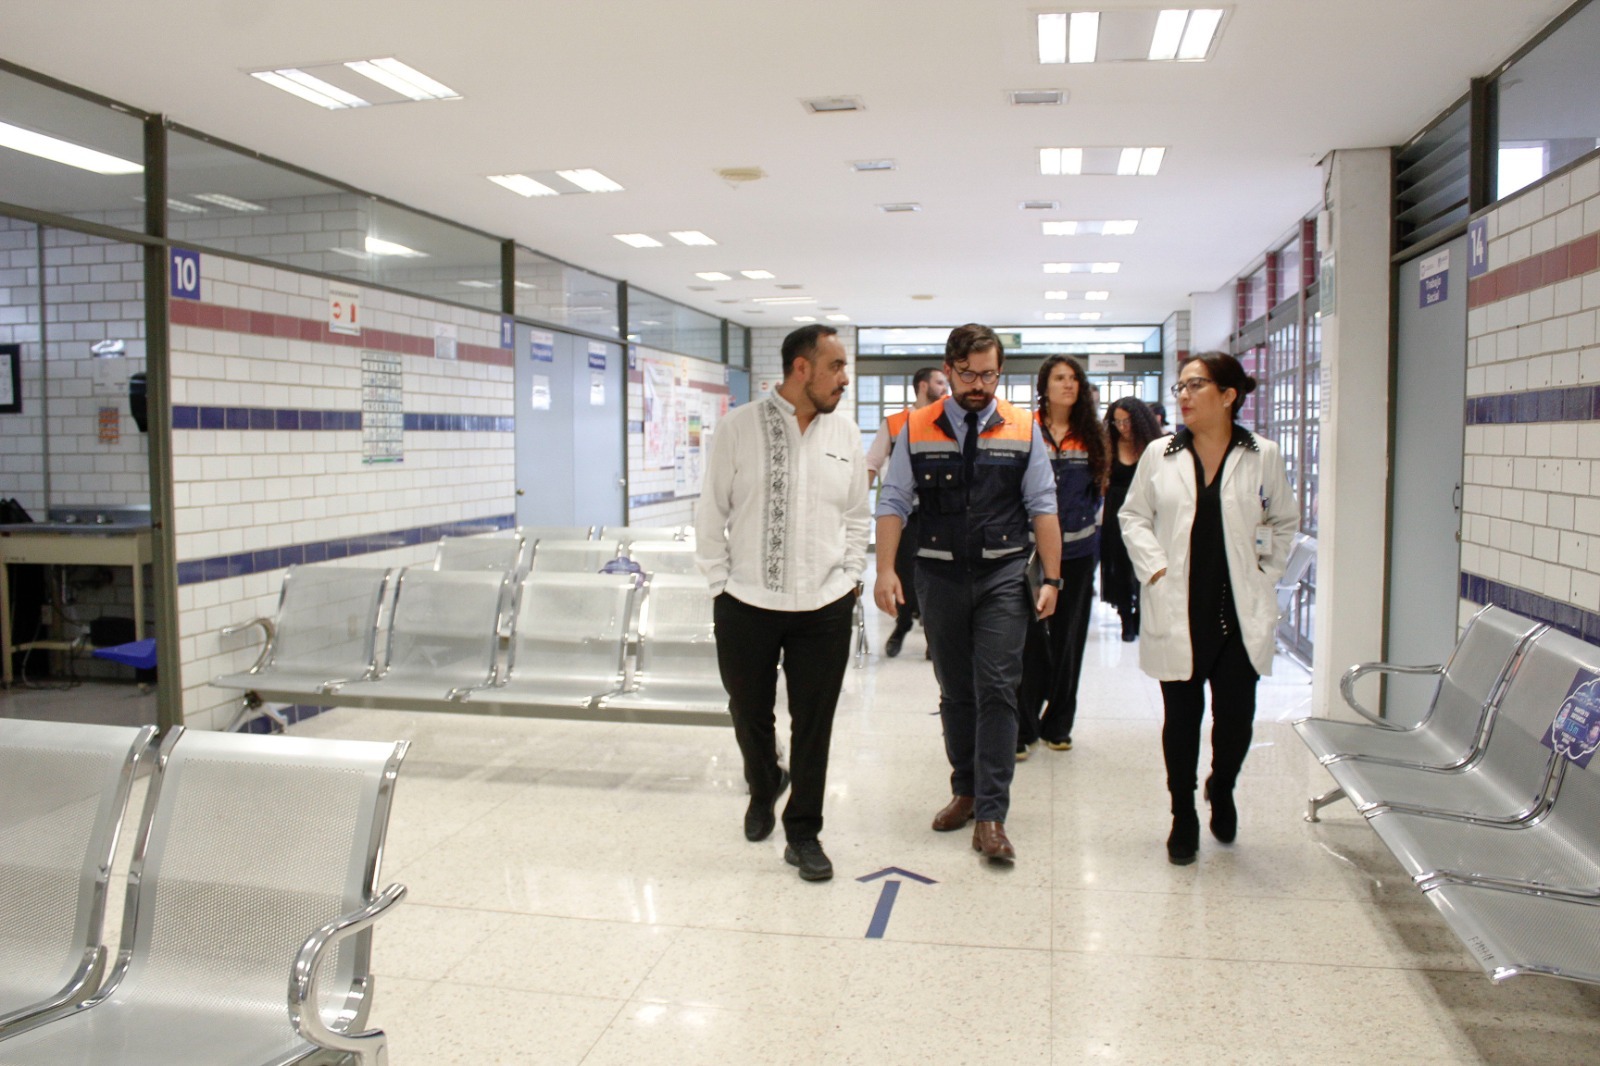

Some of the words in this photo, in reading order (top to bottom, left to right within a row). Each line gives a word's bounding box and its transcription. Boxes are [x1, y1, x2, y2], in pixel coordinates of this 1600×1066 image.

[1471, 226, 1484, 267] 14
[173, 255, 196, 291] 10
[1427, 290, 1440, 304] Social
